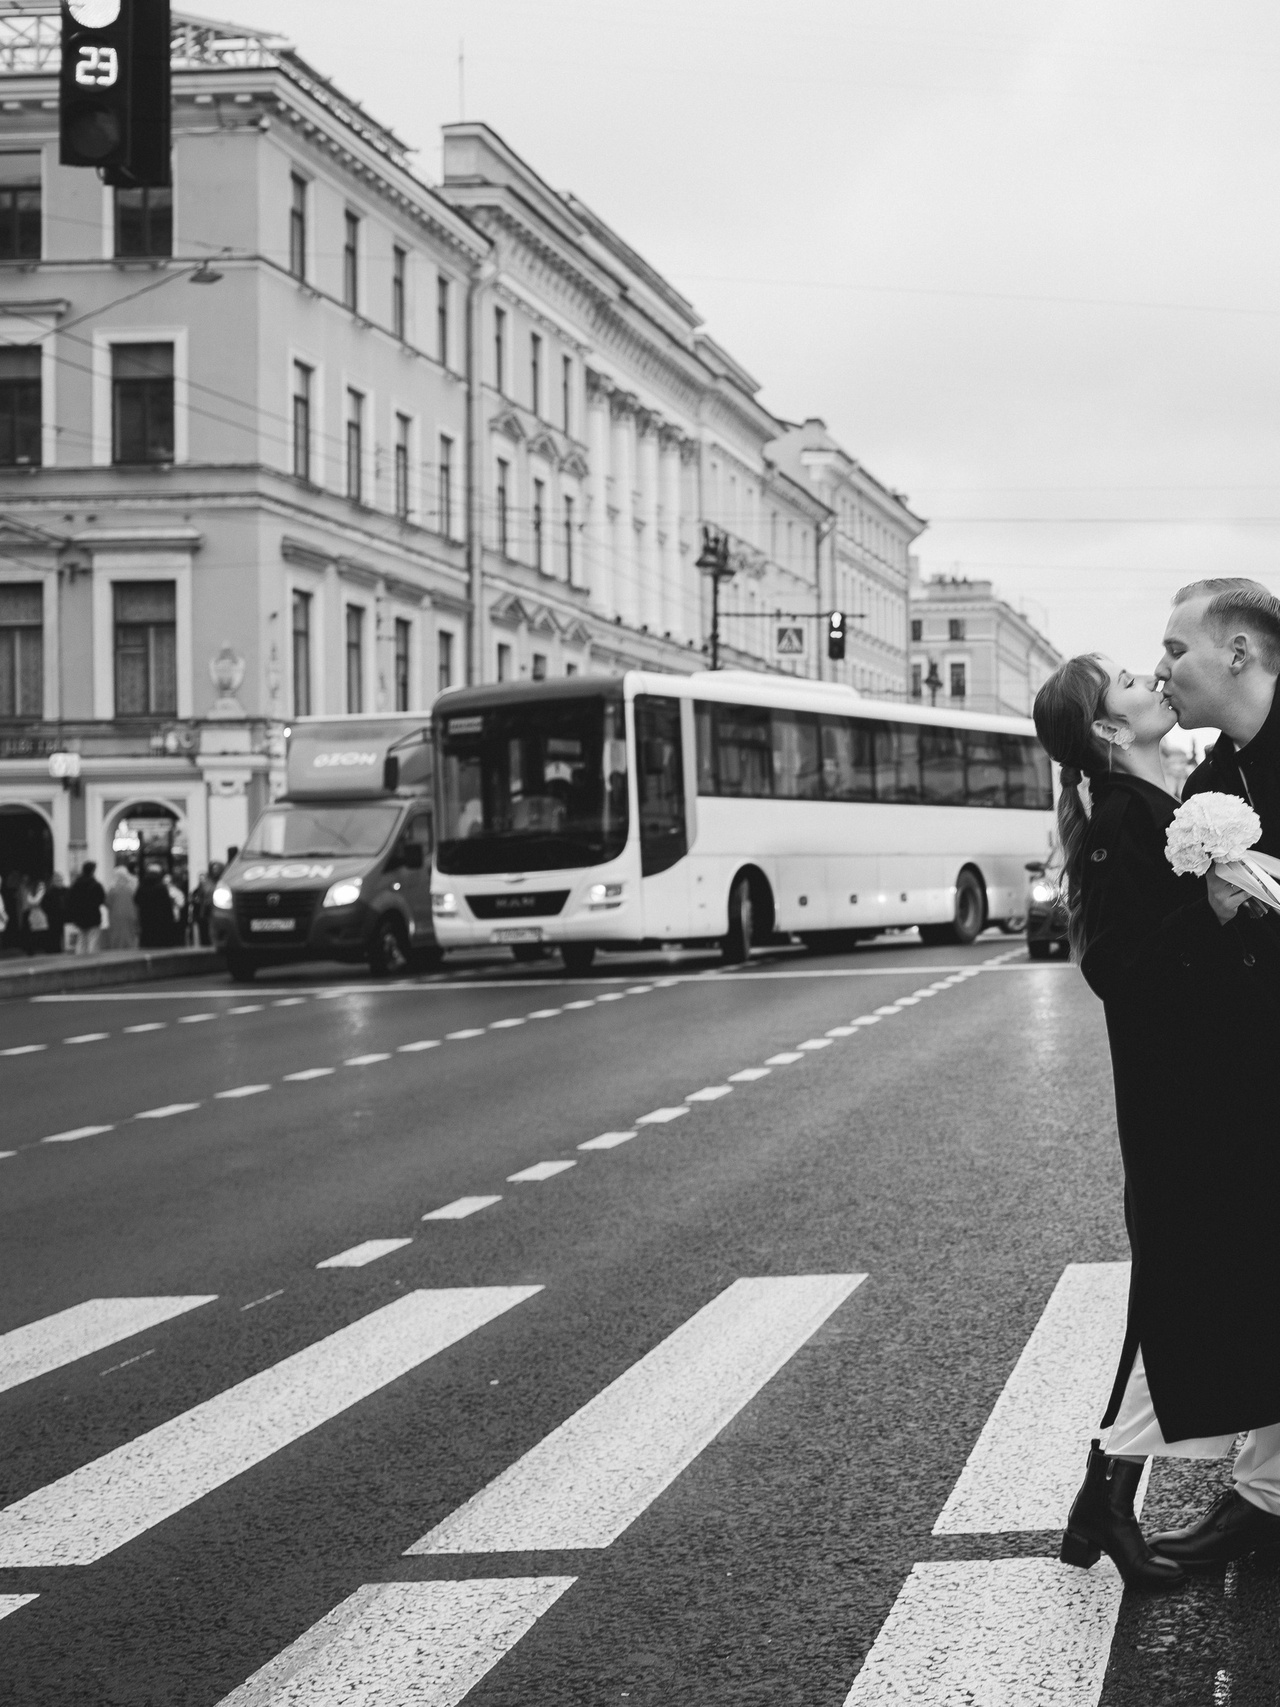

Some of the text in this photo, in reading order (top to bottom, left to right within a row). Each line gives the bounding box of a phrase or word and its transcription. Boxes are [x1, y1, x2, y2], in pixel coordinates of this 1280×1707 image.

[75, 46, 118, 86] 23
[313, 752, 378, 768] OZON
[242, 864, 335, 881] OZON
